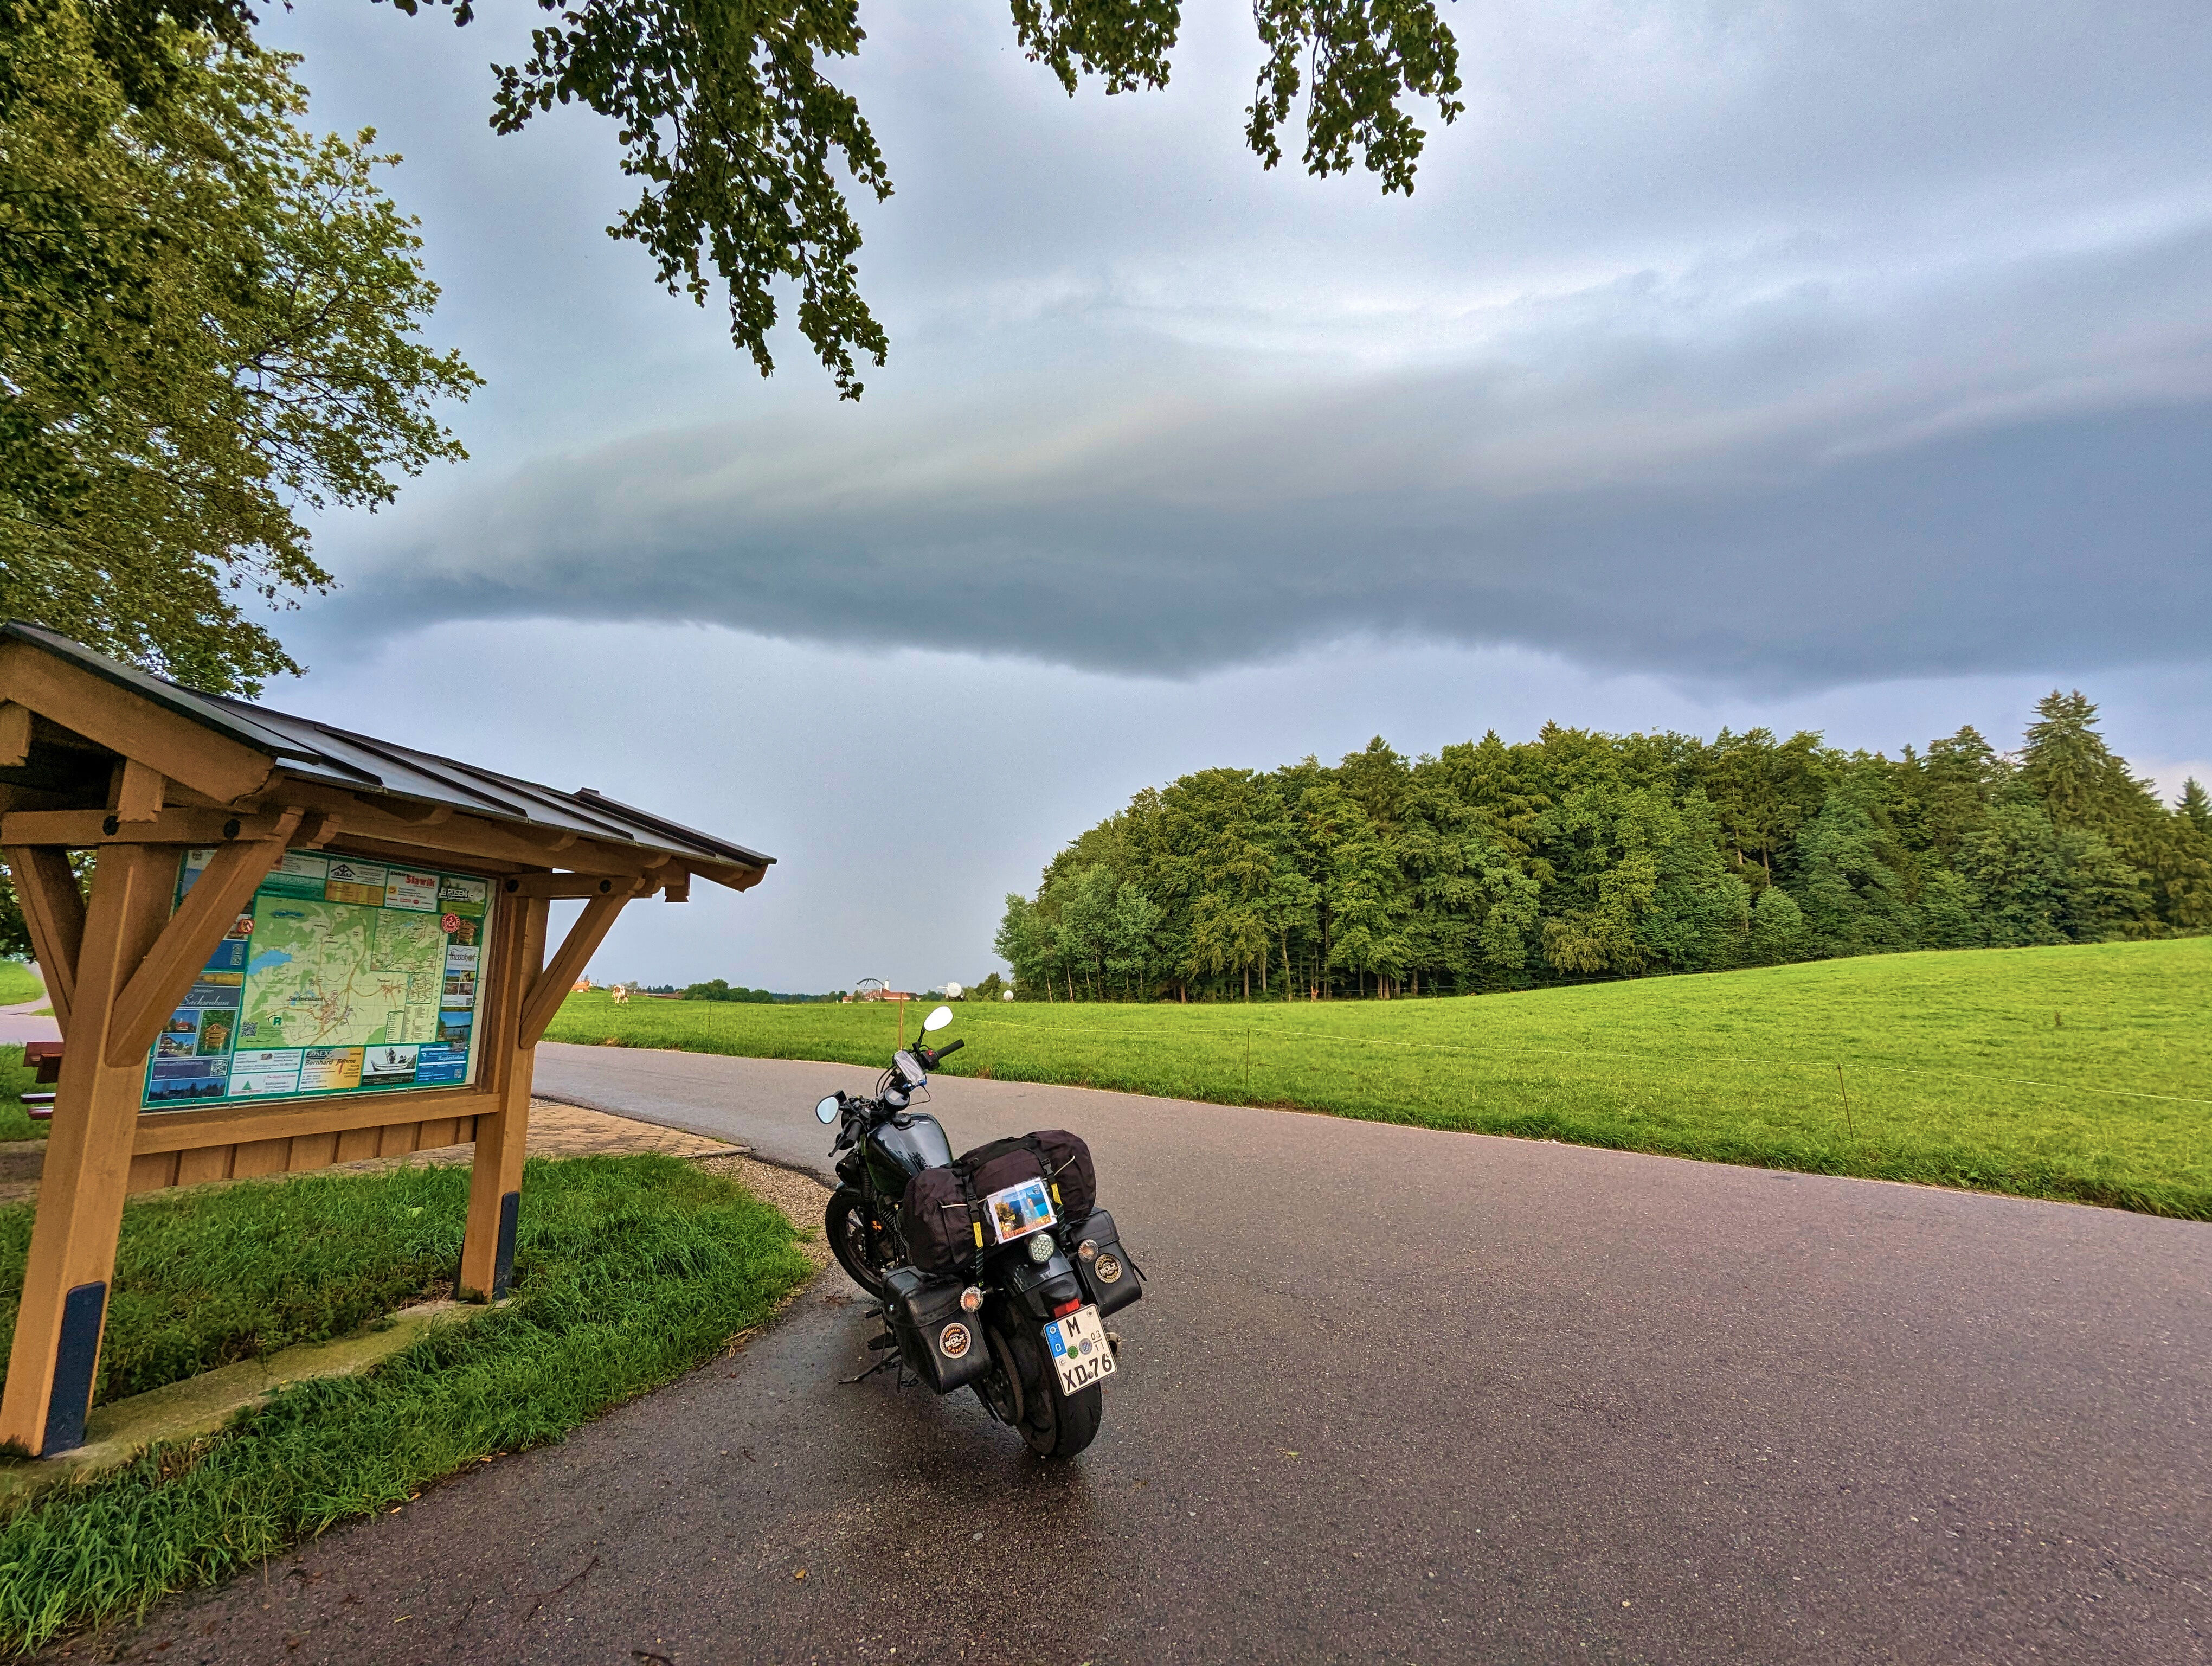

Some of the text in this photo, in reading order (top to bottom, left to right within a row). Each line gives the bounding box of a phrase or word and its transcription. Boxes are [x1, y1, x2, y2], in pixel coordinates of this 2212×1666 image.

[1100, 1262, 1116, 1274] BOLT
[1066, 1316, 1081, 1337] M
[945, 1334, 964, 1347] BOLT
[1091, 1330, 1101, 1340] 03
[1055, 1343, 1062, 1352] D
[1095, 1342, 1104, 1352] 11
[1062, 1353, 1112, 1392] XD 76
